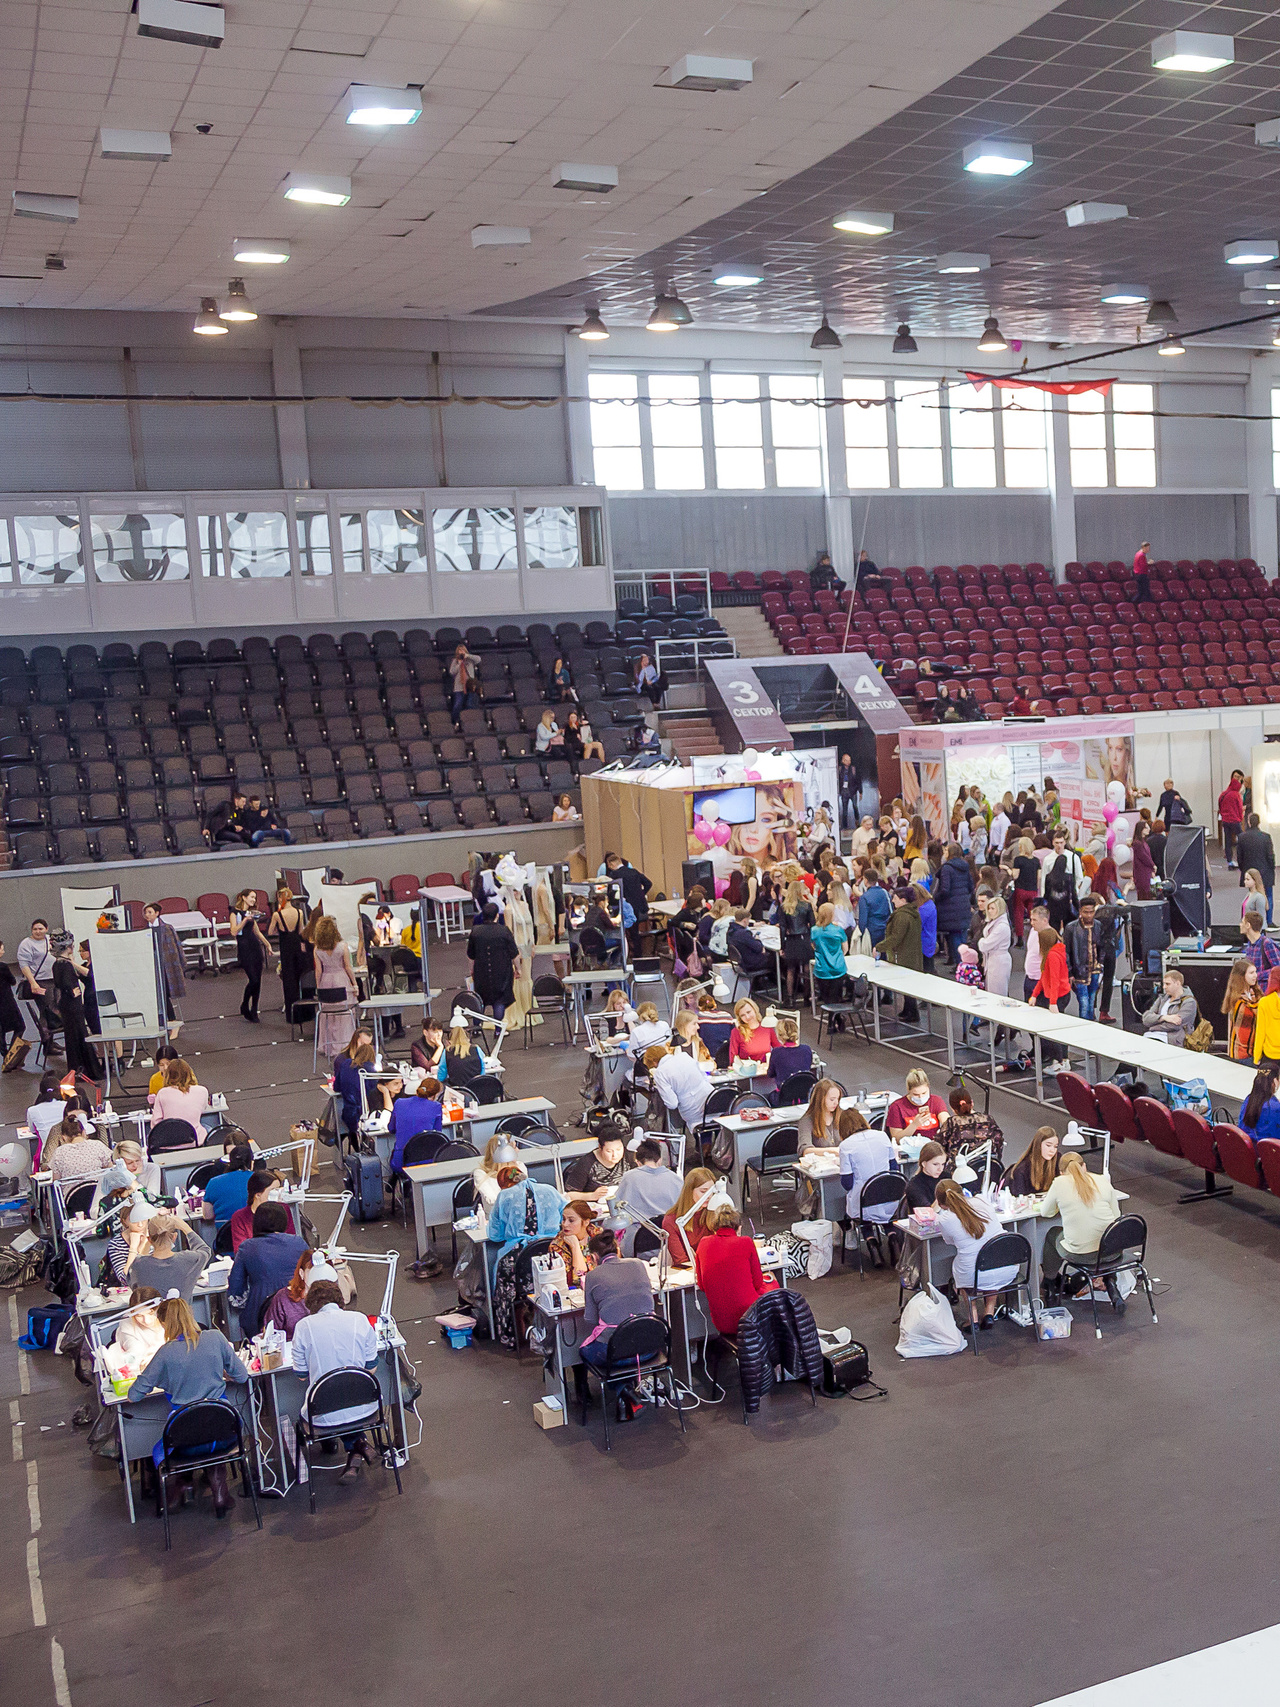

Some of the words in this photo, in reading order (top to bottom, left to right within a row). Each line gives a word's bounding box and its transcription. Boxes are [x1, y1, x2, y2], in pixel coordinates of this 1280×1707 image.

[728, 681, 760, 704] 3
[853, 674, 882, 698] 4
[733, 707, 774, 717] СЕКТОР
[857, 700, 897, 711] СЕКТОР
